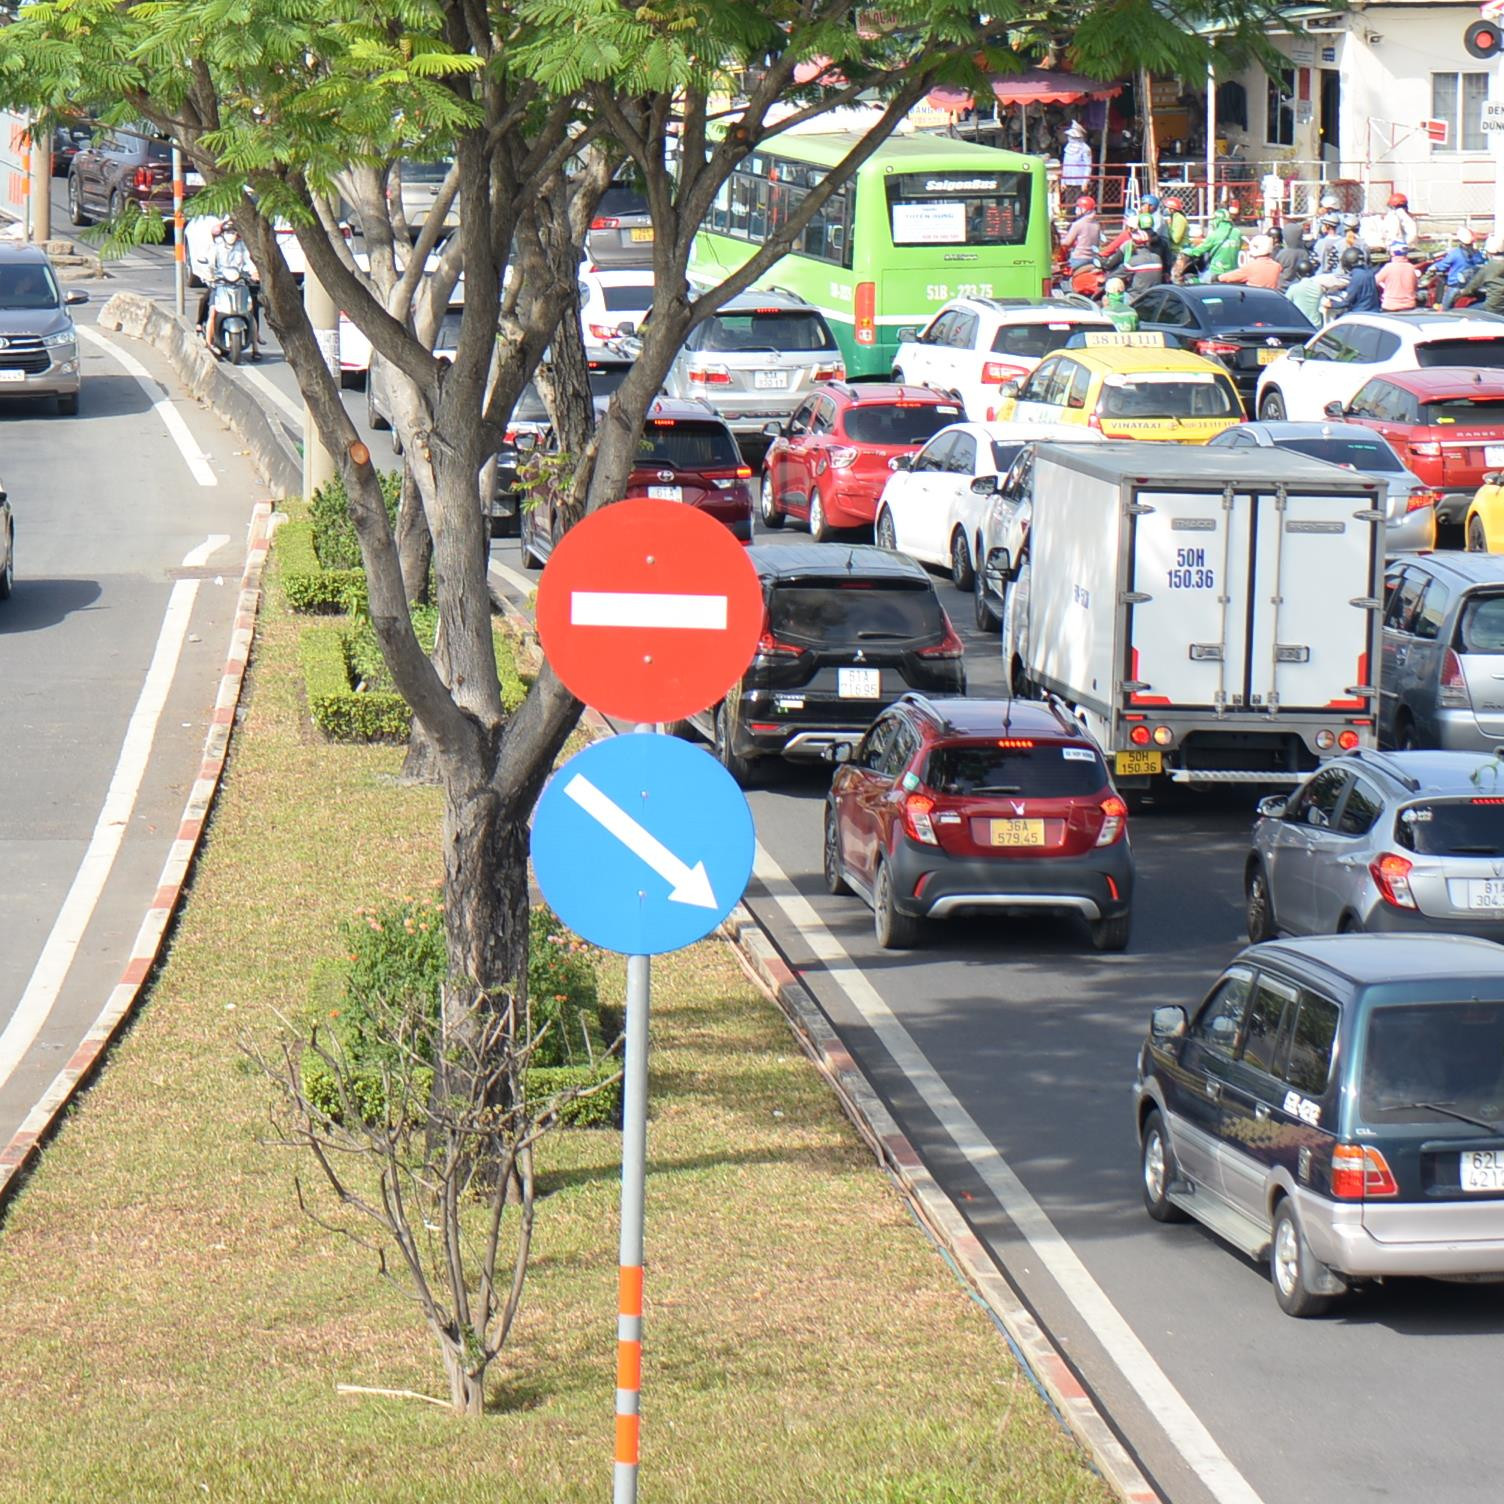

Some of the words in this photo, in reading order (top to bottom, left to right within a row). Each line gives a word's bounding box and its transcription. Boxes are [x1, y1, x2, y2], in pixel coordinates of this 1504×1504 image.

[926, 179, 998, 192] SaigonBus
[1092, 335, 1109, 345] 38
[1111, 422, 1161, 430] VINATAXI
[1177, 548, 1205, 568] 50H
[1167, 569, 1214, 590] 150.36
[1129, 751, 1150, 762] 50H
[1121, 762, 1157, 773] 150.36
[1006, 820, 1029, 832] 36A
[997, 832, 1039, 845] 579.45
[1472, 1152, 1503, 1170] 62L
